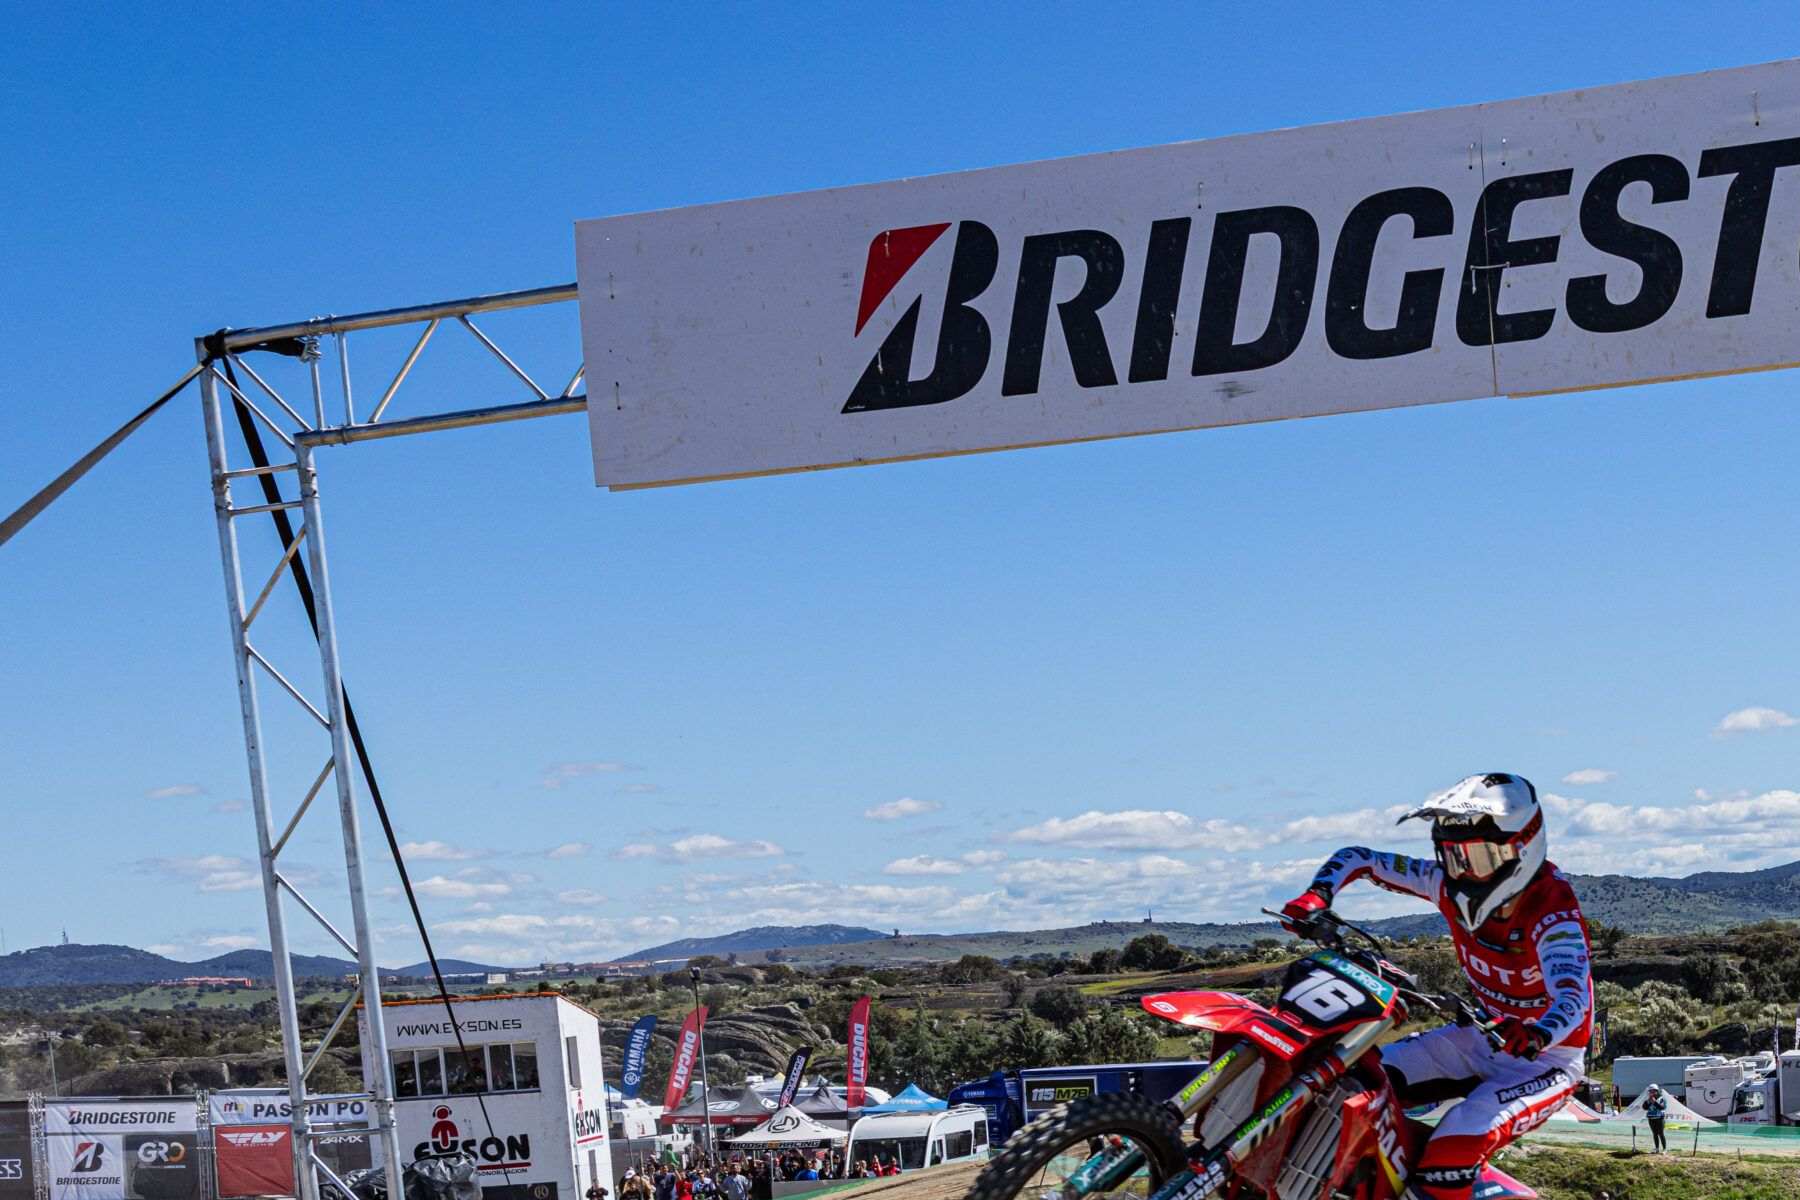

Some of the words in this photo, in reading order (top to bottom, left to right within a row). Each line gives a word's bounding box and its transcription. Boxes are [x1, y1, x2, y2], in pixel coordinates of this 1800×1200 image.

[1328, 957, 1387, 996] MOTOREX
[1460, 944, 1543, 986] OTS
[1281, 968, 1366, 1022] 16
[397, 1019, 522, 1036] WWW.EXSON.ES
[627, 1028, 647, 1072] YAMAHA
[672, 1030, 697, 1090] DUCATI
[852, 1023, 865, 1083] DUCATI
[68, 1111, 176, 1125] BRIDGESTONE
[730, 1142, 768, 1150] MOOSE
[779, 1139, 820, 1148] RACING
[56, 1176, 121, 1186] BRIDGESTONE
